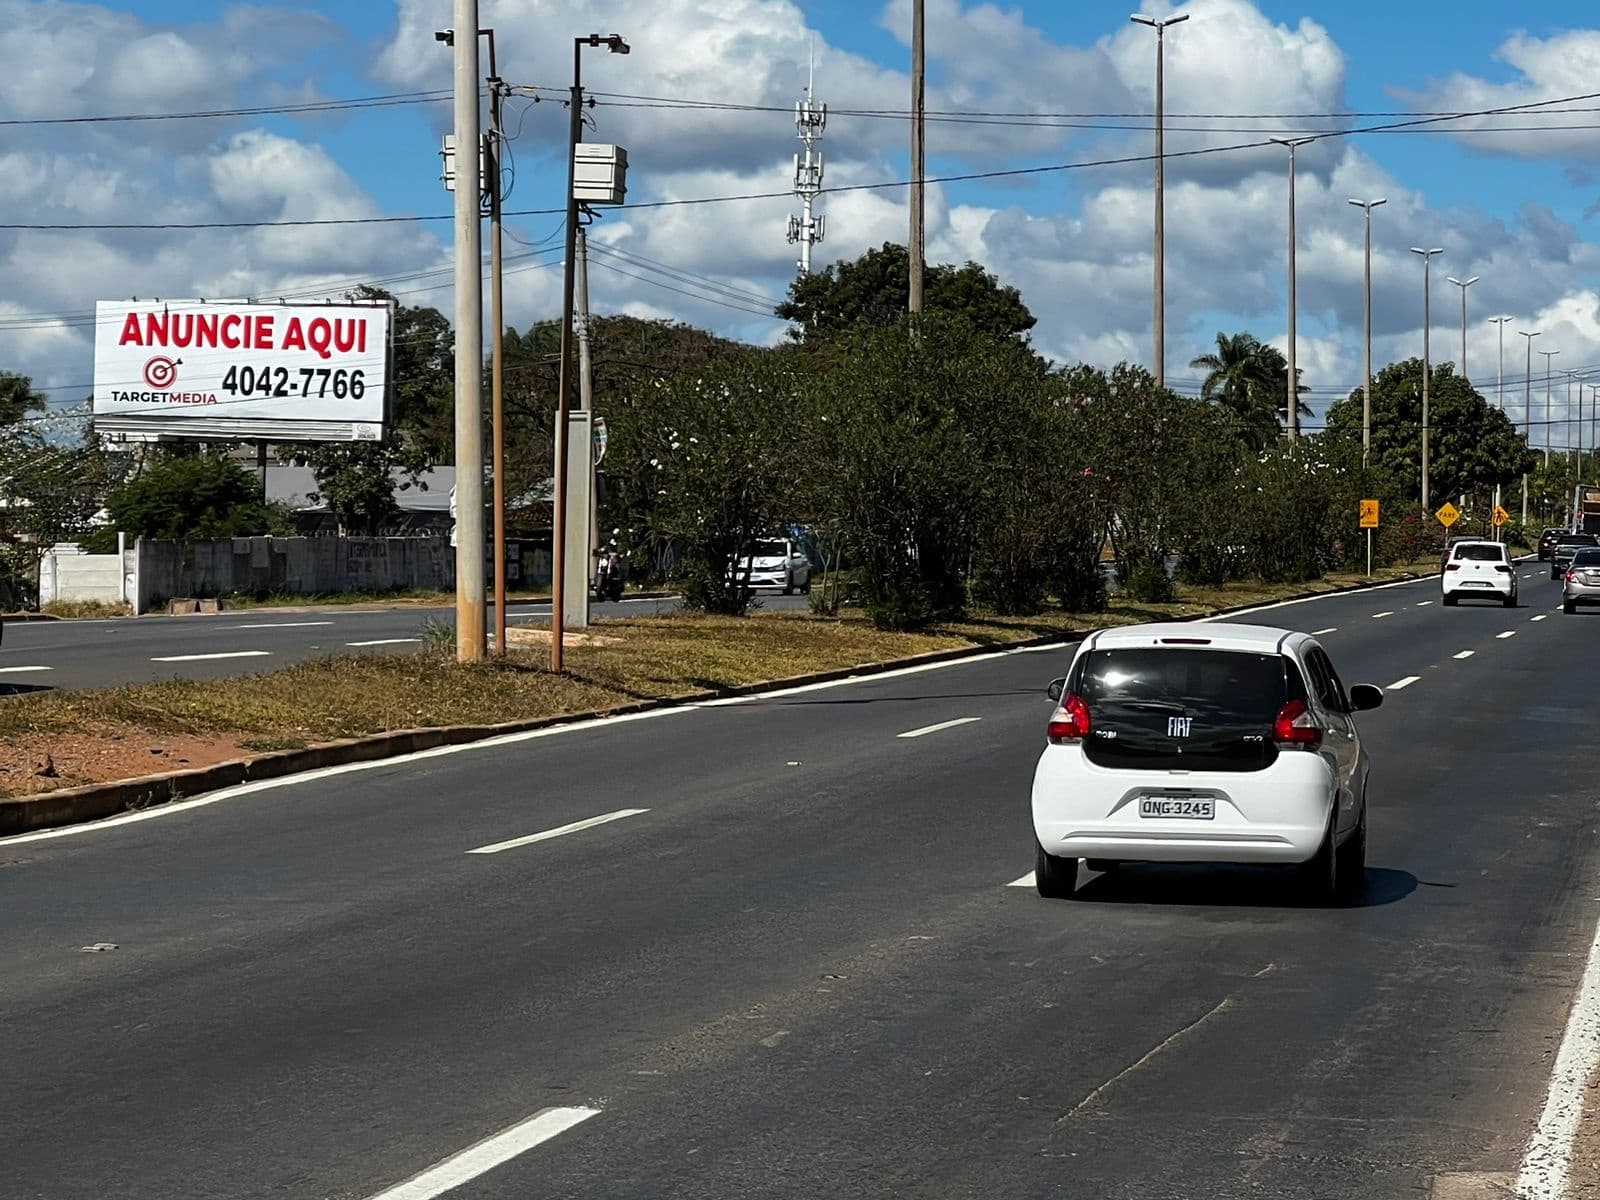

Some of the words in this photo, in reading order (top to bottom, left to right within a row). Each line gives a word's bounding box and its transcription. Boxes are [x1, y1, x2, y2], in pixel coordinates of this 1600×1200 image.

[118, 312, 274, 349] ANUNCIE
[281, 317, 367, 359] AQUI
[222, 365, 365, 400] 4042-7766
[111, 390, 217, 405] TARGETMEDIA
[1167, 717, 1193, 738] FIAT
